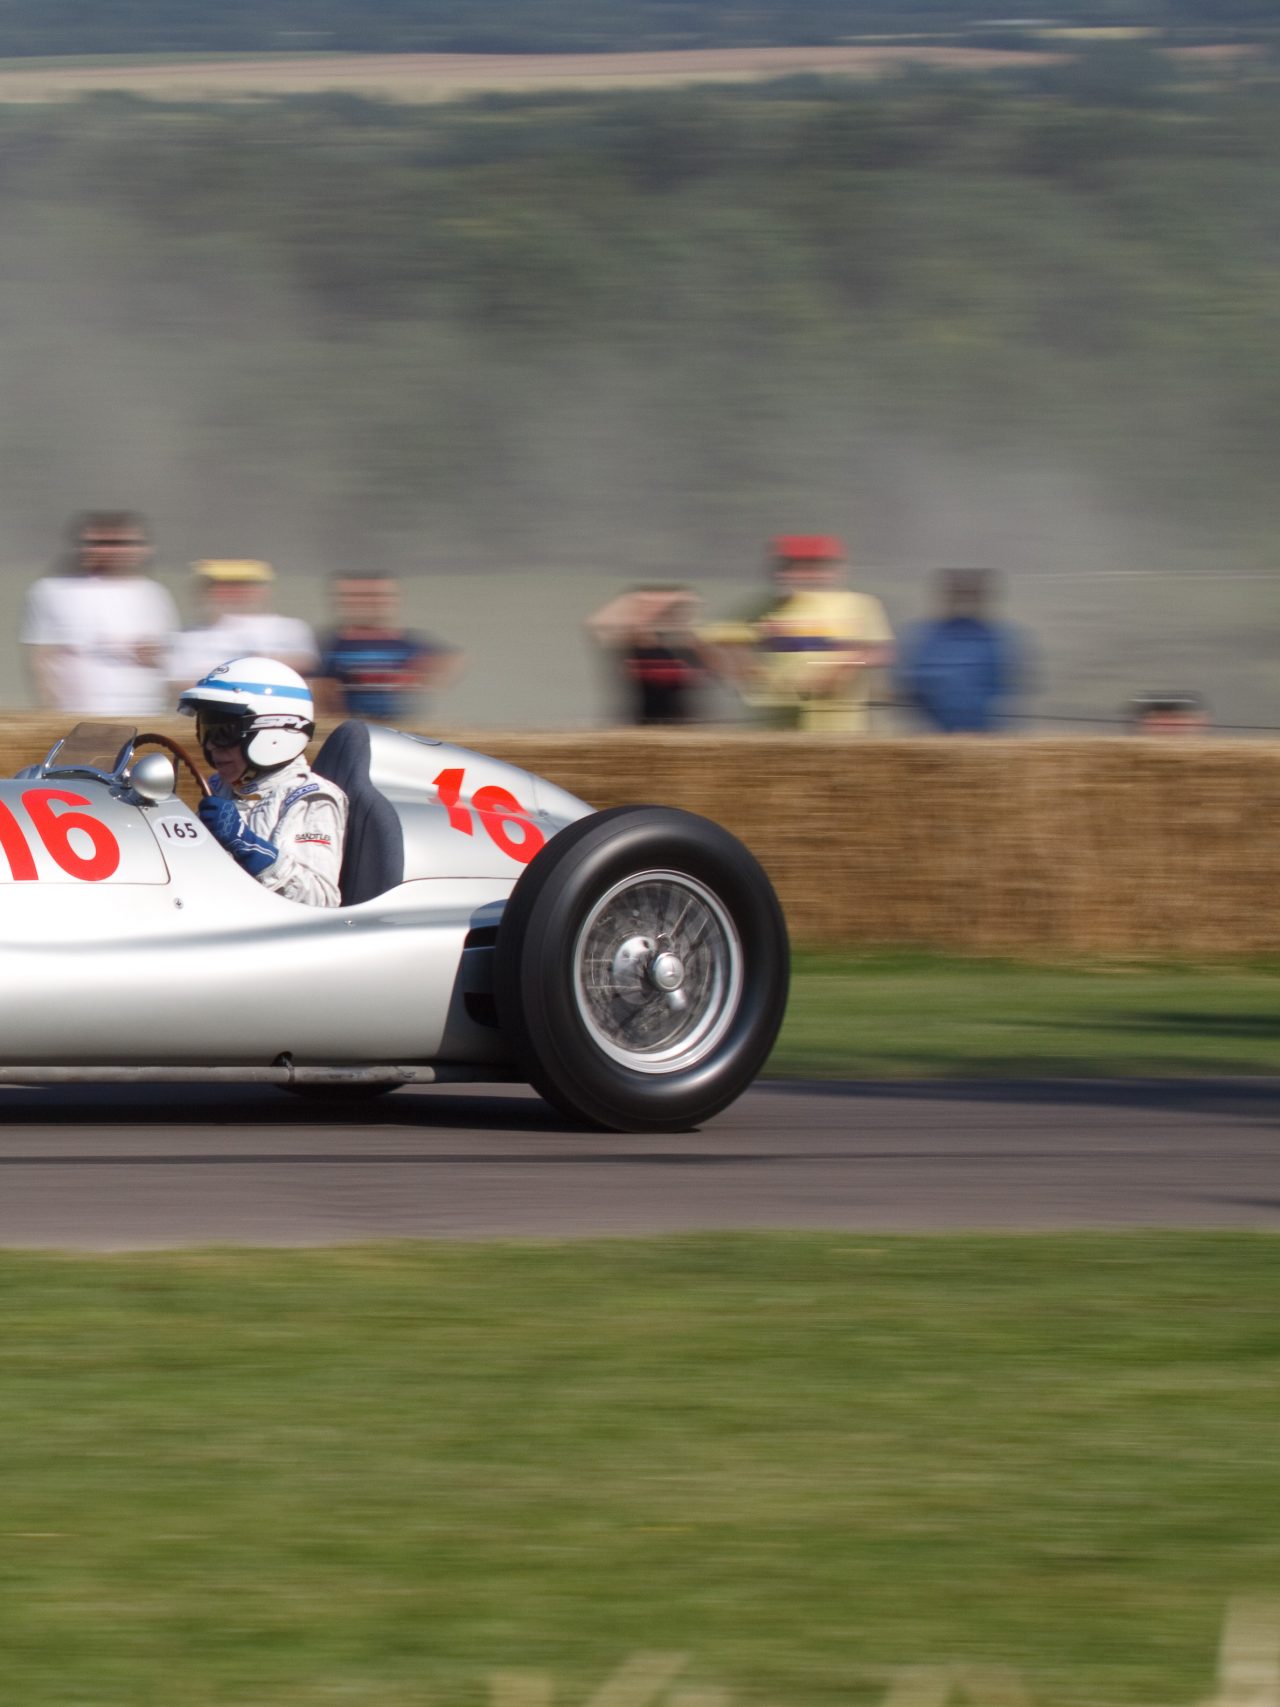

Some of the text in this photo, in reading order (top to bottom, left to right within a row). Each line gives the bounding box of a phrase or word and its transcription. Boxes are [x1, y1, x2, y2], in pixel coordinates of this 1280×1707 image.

[250, 715, 310, 729] SPY
[432, 768, 546, 865] 16
[161, 822, 197, 839] 165
